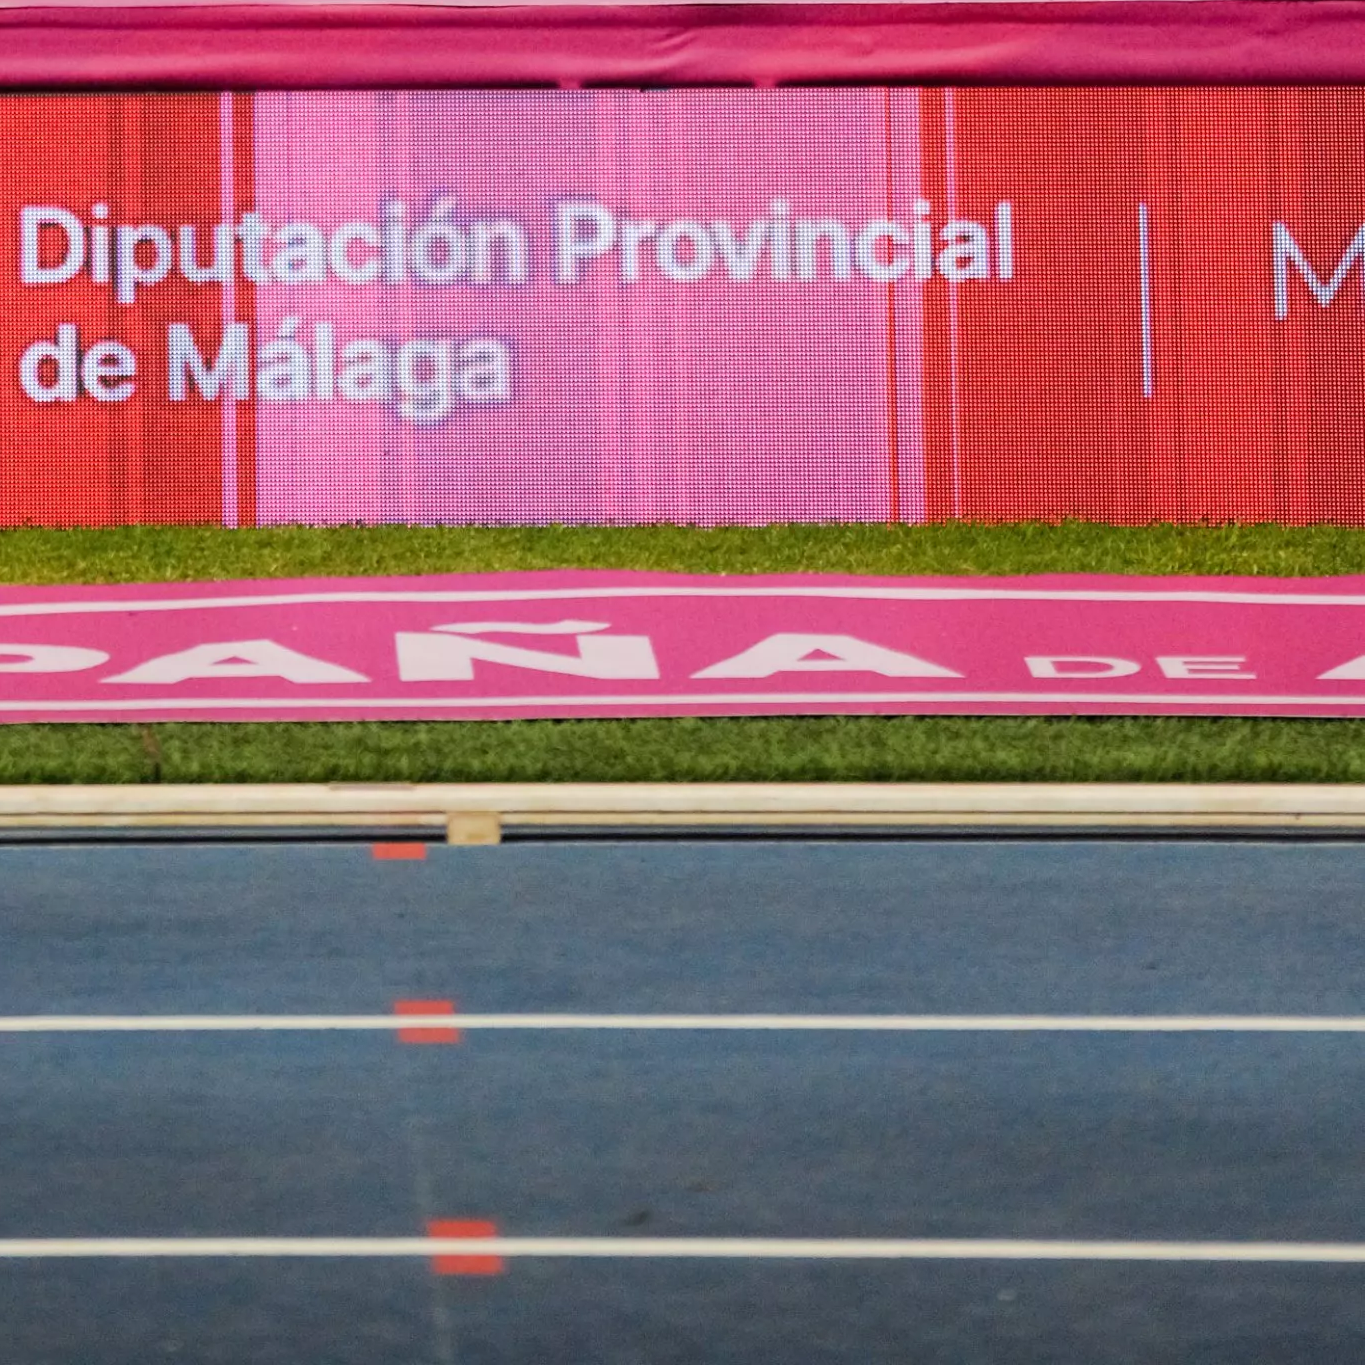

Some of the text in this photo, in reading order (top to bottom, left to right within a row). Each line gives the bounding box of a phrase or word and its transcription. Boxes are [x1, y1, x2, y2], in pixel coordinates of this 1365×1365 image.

[19, 195, 1014, 303] Diputación Provincial
[19, 316, 513, 425] de Málaga
[1024, 654, 1258, 681] DE
